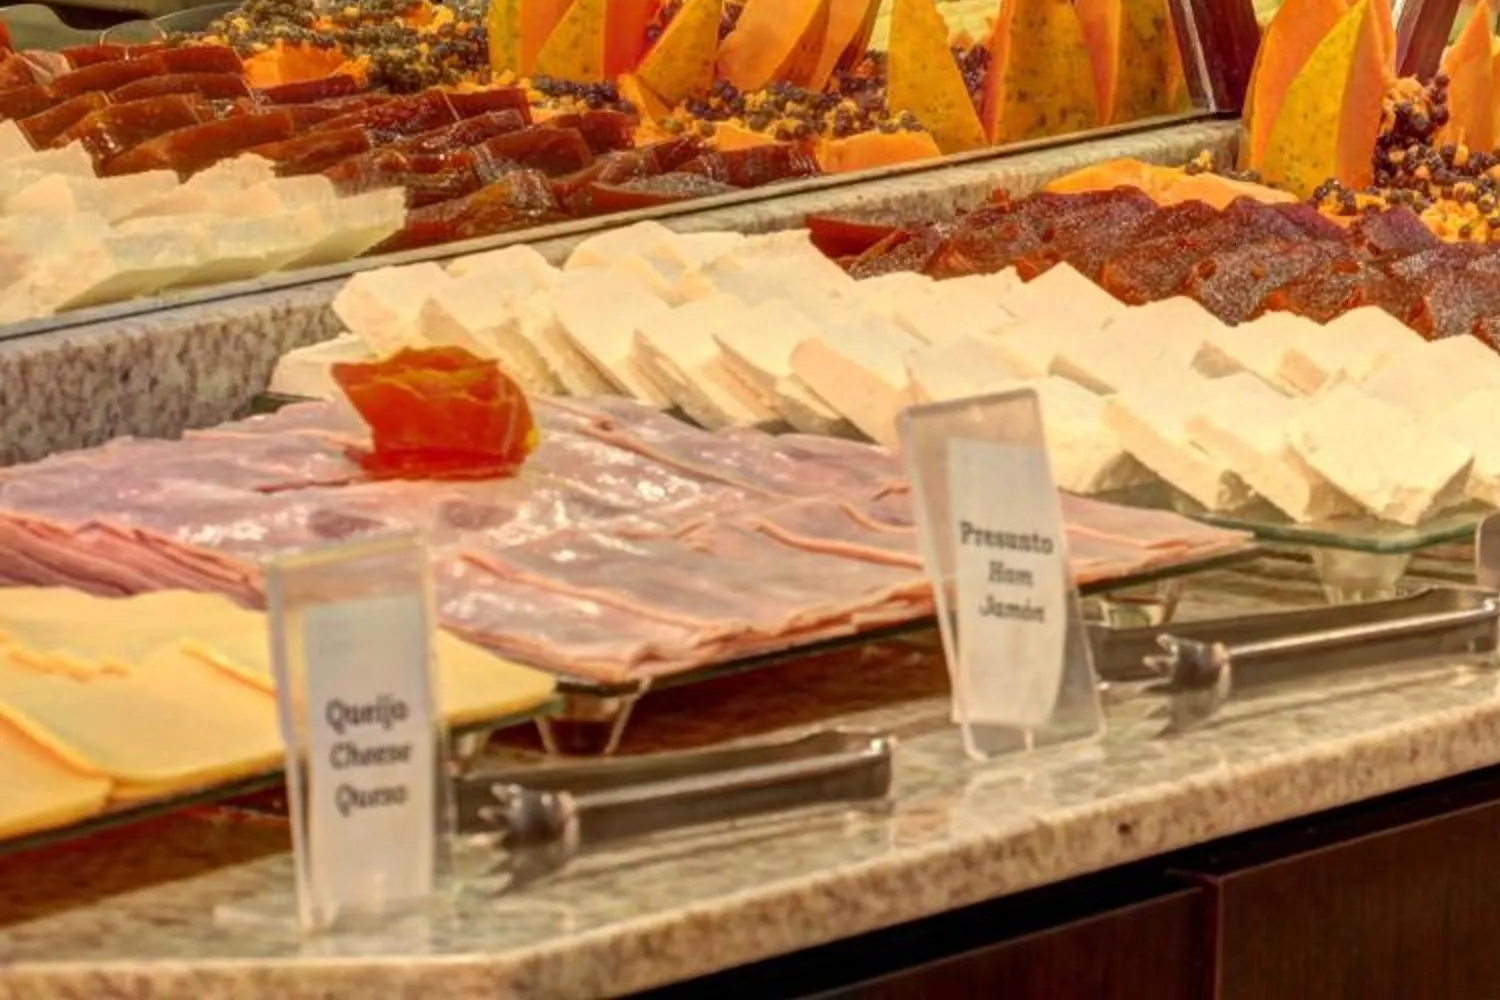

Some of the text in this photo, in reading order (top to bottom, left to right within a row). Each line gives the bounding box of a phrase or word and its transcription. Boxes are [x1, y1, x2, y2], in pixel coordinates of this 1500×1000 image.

[960, 520, 1054, 555] Presunto
[325, 694, 409, 735] Queijo
[329, 741, 413, 770] Cheese
[335, 784, 407, 817] Queso
